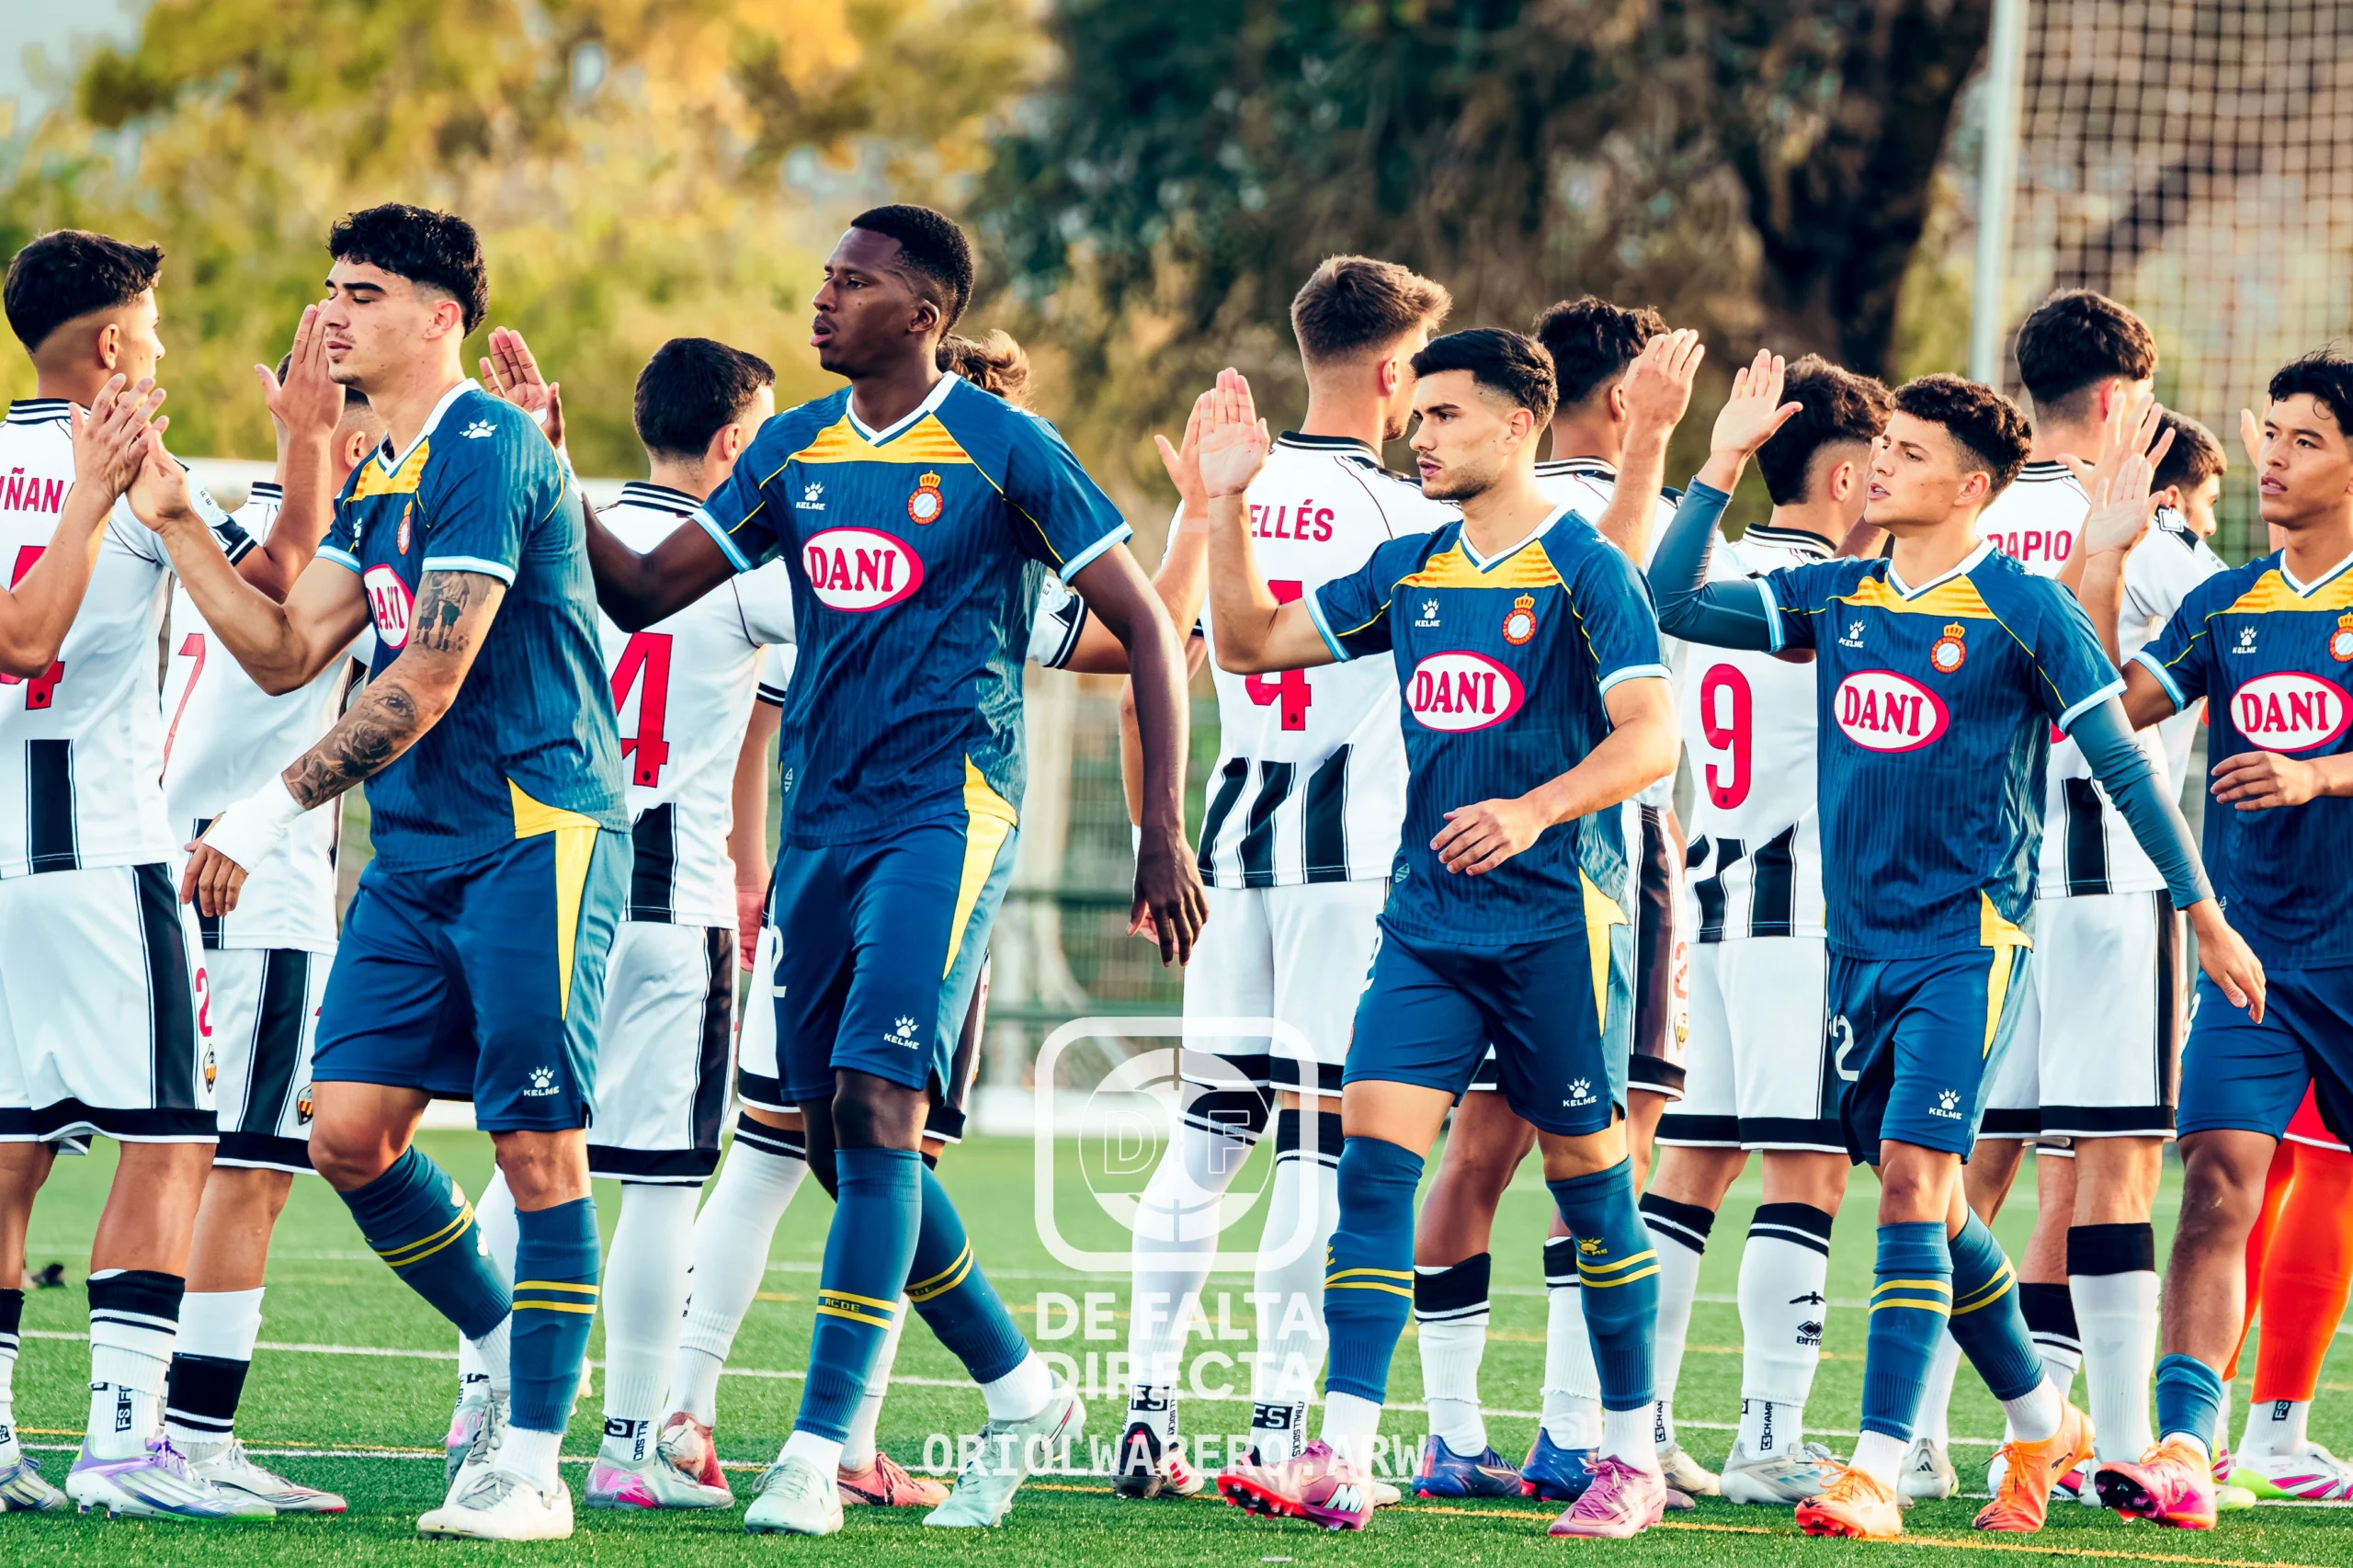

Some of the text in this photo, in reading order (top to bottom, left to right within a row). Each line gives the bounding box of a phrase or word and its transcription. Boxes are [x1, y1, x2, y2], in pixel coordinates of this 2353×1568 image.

[0, 467, 75, 513] ÑAN
[796, 501, 825, 510] KELME
[808, 546, 896, 592] DANI
[1415, 670, 1496, 714] DANI
[1843, 685, 1923, 736] DANI
[2240, 691, 2329, 733] DANI
[1700, 664, 1752, 810] 9
[883, 1032, 920, 1050] KELME
[1828, 1007, 1859, 1082] 2
[523, 1085, 560, 1096] KELME
[1563, 1095, 1597, 1108] KELME
[1928, 1107, 1962, 1120] KELME
[825, 1298, 859, 1312] RCDE
[1131, 1386, 1165, 1410] FS
[2275, 1402, 2289, 1418] FS
[1253, 1403, 1287, 1428] FS
[1295, 1401, 1305, 1428] TBALL
